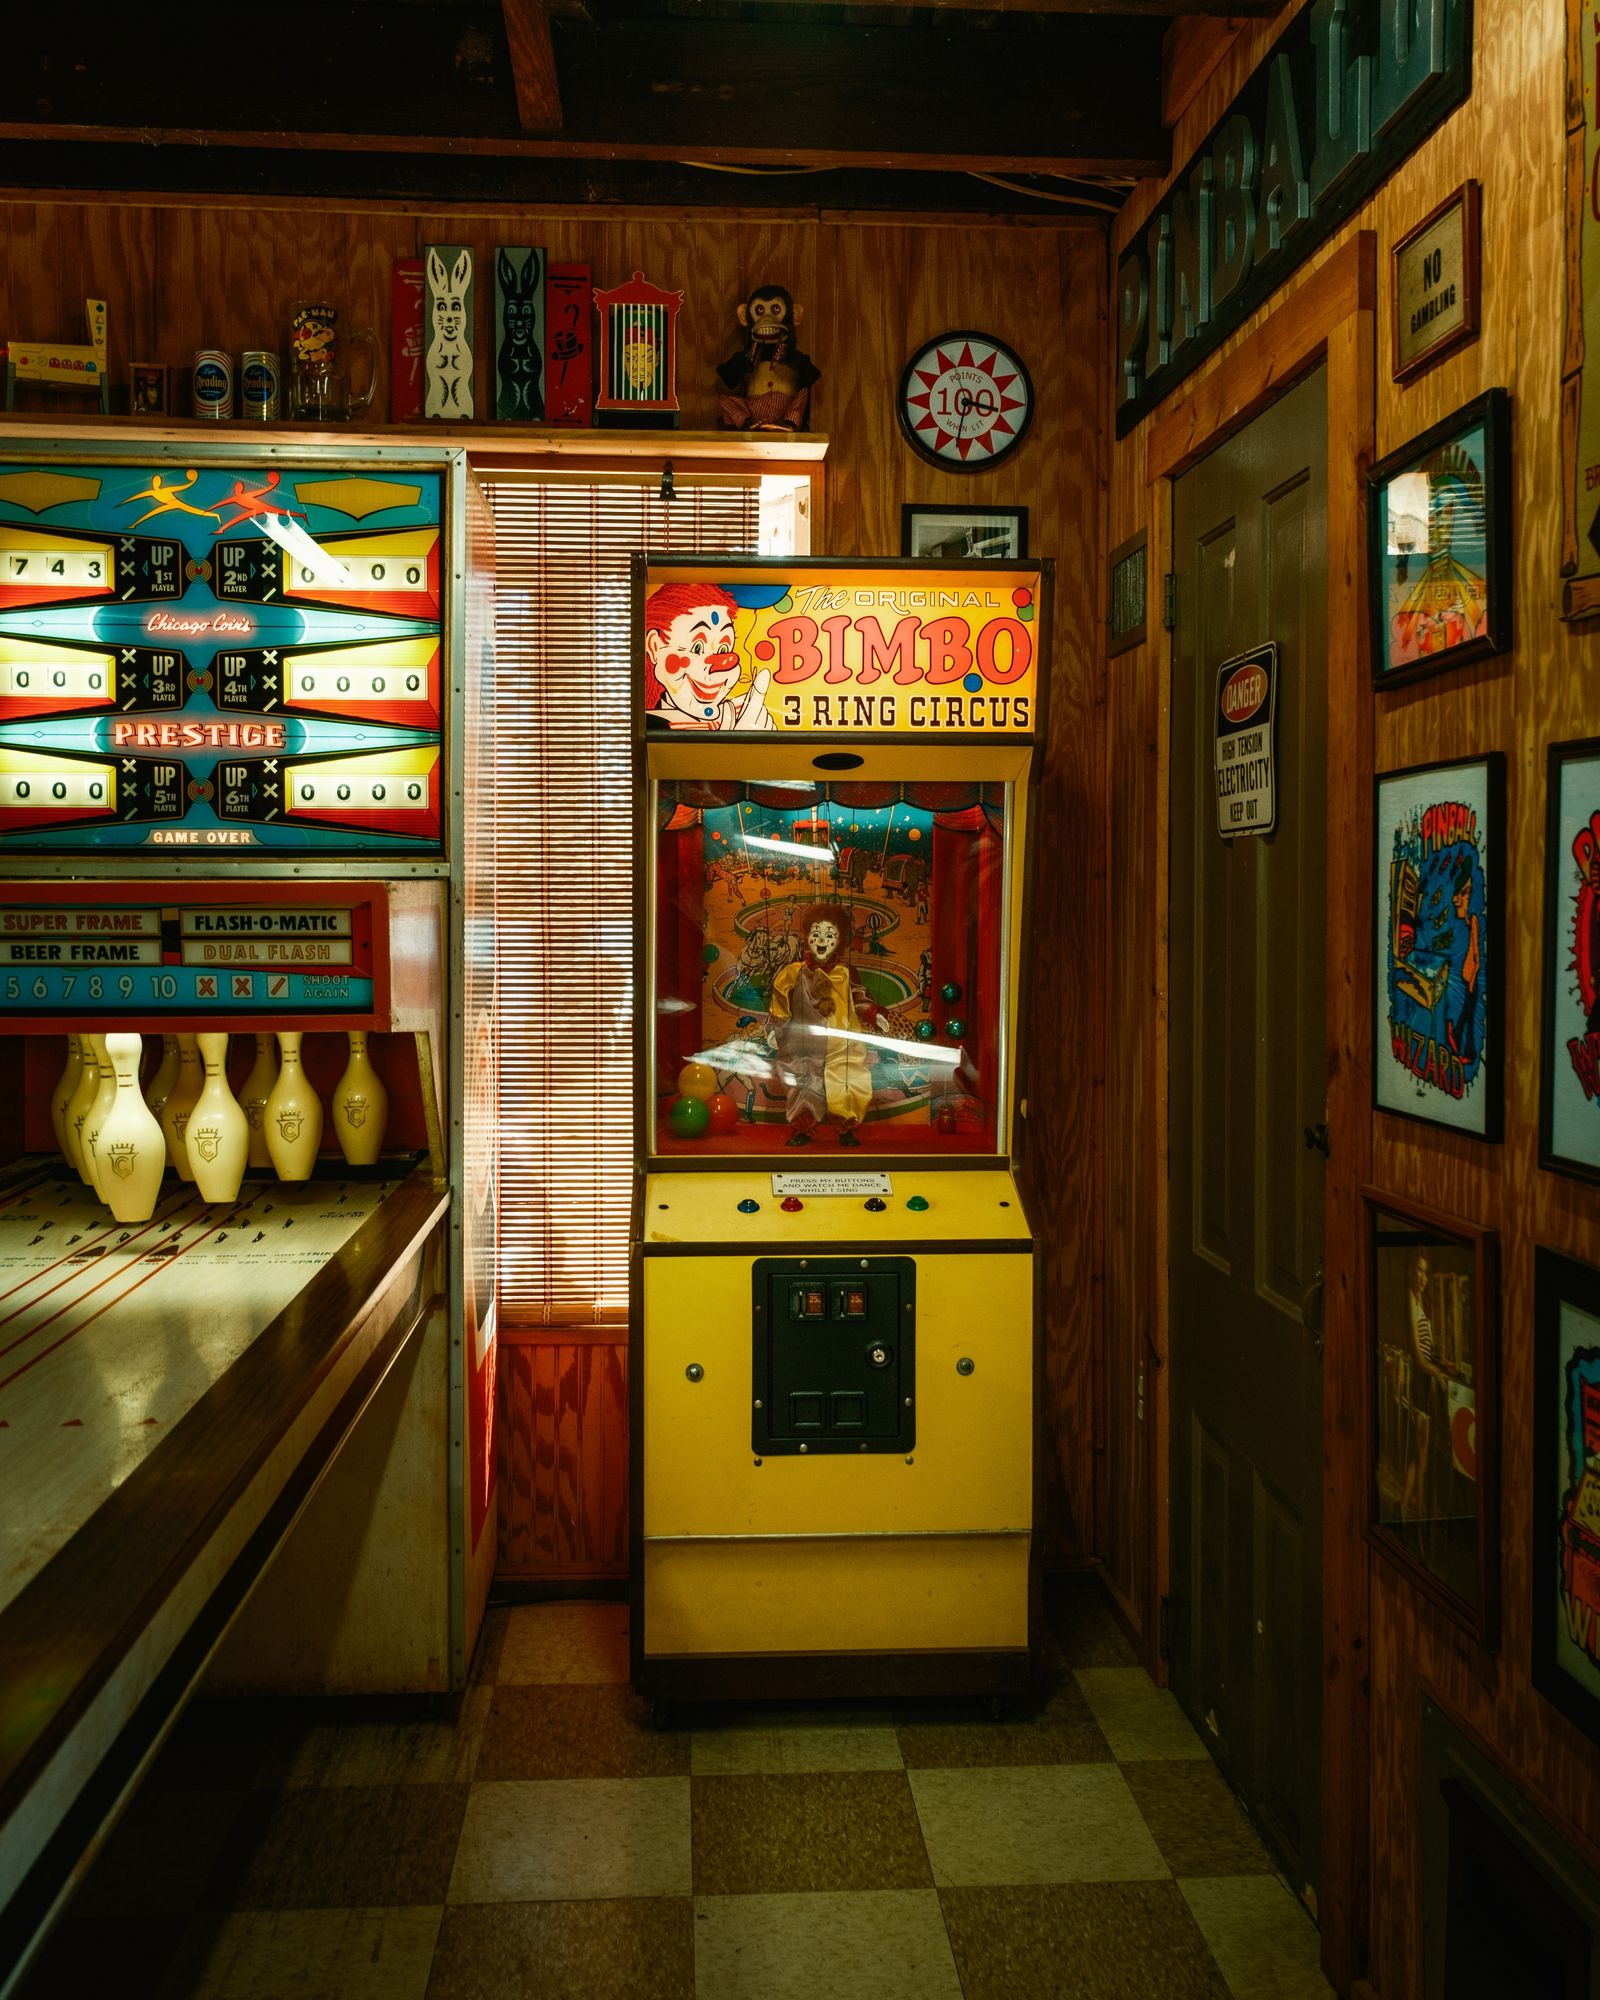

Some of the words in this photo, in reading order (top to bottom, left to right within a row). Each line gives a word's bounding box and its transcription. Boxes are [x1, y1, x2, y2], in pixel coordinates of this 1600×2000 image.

[1423, 248, 1442, 292] NO
[1410, 284, 1456, 335] GAMBLING
[950, 372, 983, 383] POINTS
[937, 387, 994, 417] 100
[971, 420, 984, 432] LIT
[151, 546, 174, 566] UP
[223, 547, 245, 567] UP
[155, 570, 173, 584] 1ST
[224, 571, 248, 585] 2ND
[151, 584, 175, 592] PLAYER
[223, 585, 247, 593] PLAYER
[796, 585, 850, 615] The
[854, 591, 1001, 615] ORIGINAL
[148, 613, 211, 634] Chicago
[767, 615, 1032, 685] BIMBO
[152, 656, 175, 676] UP
[224, 657, 247, 677] UP
[152, 680, 176, 694] 3RD
[224, 681, 247, 694] 4TH
[1226, 674, 1262, 714] DANGER
[152, 694, 176, 702] PLAYER
[224, 695, 248, 703] PLAYER
[784, 696, 801, 727] 3
[813, 696, 896, 727] RING
[910, 696, 1030, 727] CIRCUS
[114, 723, 287, 748] PRESTIGE
[1222, 738, 1236, 761] HIGH
[1238, 731, 1263, 757] TENSION
[154, 767, 176, 787] UP
[225, 767, 247, 787] UP
[1218, 757, 1269, 797] ELECTRICITY
[154, 790, 177, 804] 5TH
[226, 791, 249, 804] 6TH
[154, 804, 177, 812] PLAYER
[226, 805, 249, 813] PLAYER
[1230, 802, 1243, 822] KEEP
[1246, 799, 1258, 820] OUT
[153, 831, 199, 843] GAME
[207, 831, 250, 843] OVER
[1422, 802, 1477, 859] PINBALL
[4, 914, 67, 930] SUPER
[76, 915, 142, 930] FRAME
[11, 945, 61, 960] BEER
[71, 945, 140, 960] FRAME
[204, 944, 259, 960] DUAL
[269, 944, 330, 960] FLASH
[7, 977, 20, 998] 5
[32, 977, 48, 998] 6
[63, 977, 77, 998] 7
[89, 976, 103, 999] 8
[118, 976, 134, 998] 9
[152, 976, 177, 998] 10
[303, 975, 349, 985] SHOOT
[304, 988, 349, 998] AGAIN
[1389, 1015, 1466, 1100] WIZARD
